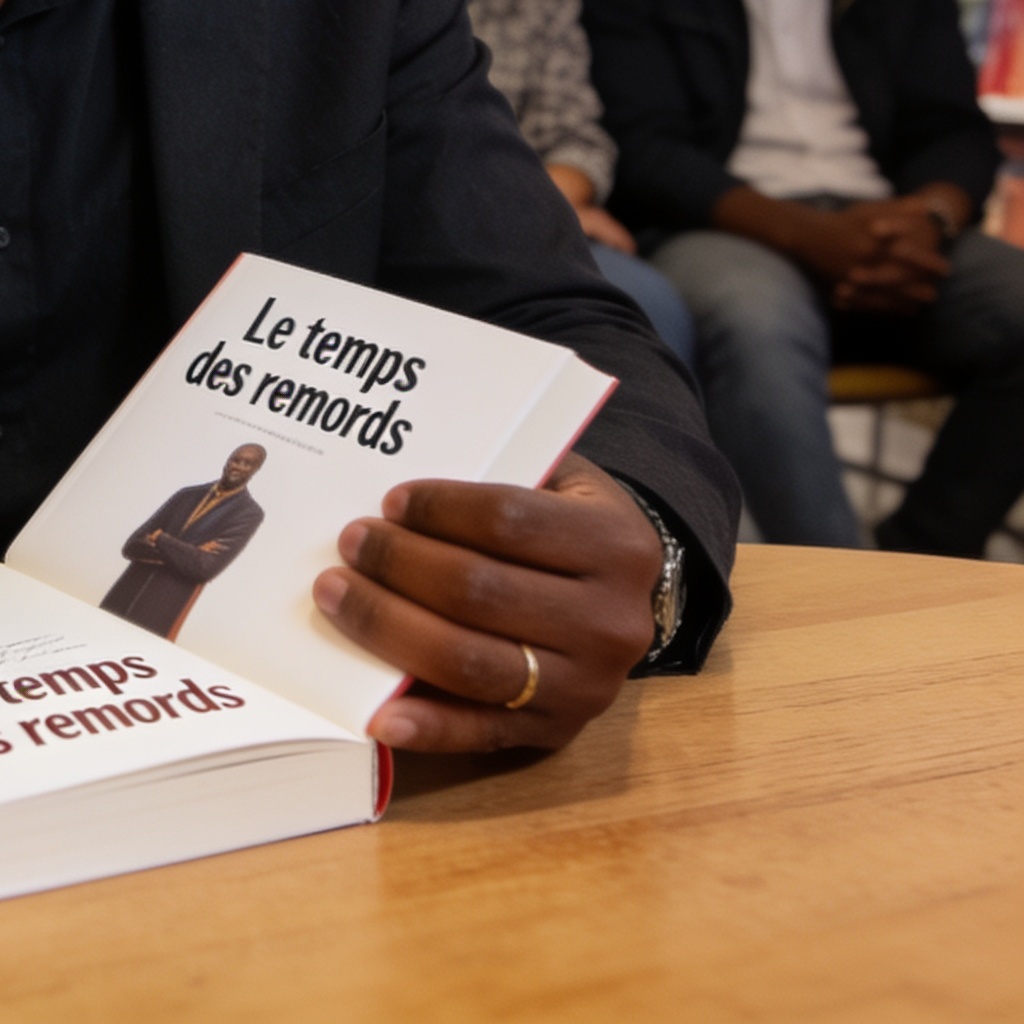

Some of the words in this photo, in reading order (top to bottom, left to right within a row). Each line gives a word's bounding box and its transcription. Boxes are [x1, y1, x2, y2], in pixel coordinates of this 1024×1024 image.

[242, 296, 296, 350] Le
[298, 318, 427, 394] temps
[185, 341, 253, 397] des
[249, 372, 413, 456] remords
[17, 678, 246, 747] remords
